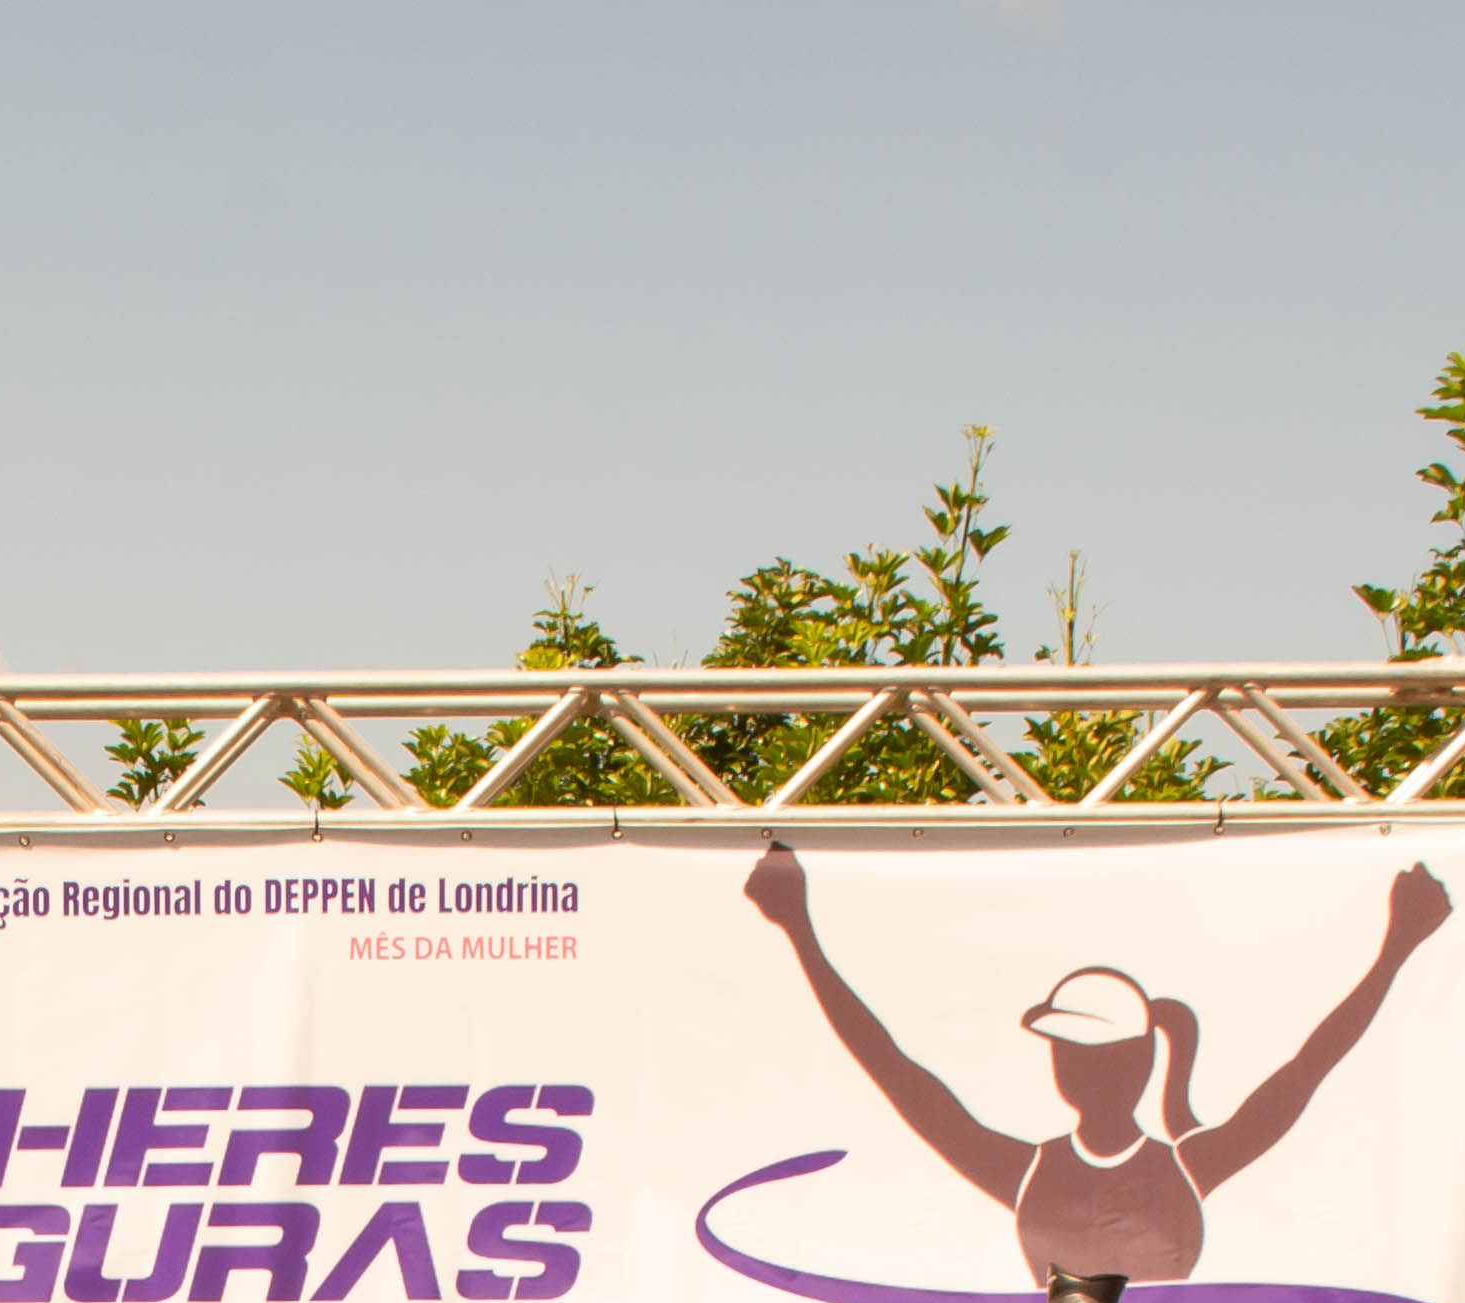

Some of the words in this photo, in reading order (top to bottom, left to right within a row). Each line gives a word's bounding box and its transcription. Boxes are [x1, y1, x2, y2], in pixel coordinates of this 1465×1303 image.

[63, 879, 201, 921] Regional
[214, 879, 252, 915] do
[265, 878, 375, 914] DEPPEN
[388, 878, 426, 913] de
[438, 875, 579, 913] Londrina
[349, 932, 406, 961] MÊS
[414, 936, 453, 961] DA
[461, 935, 578, 961] MULHER
